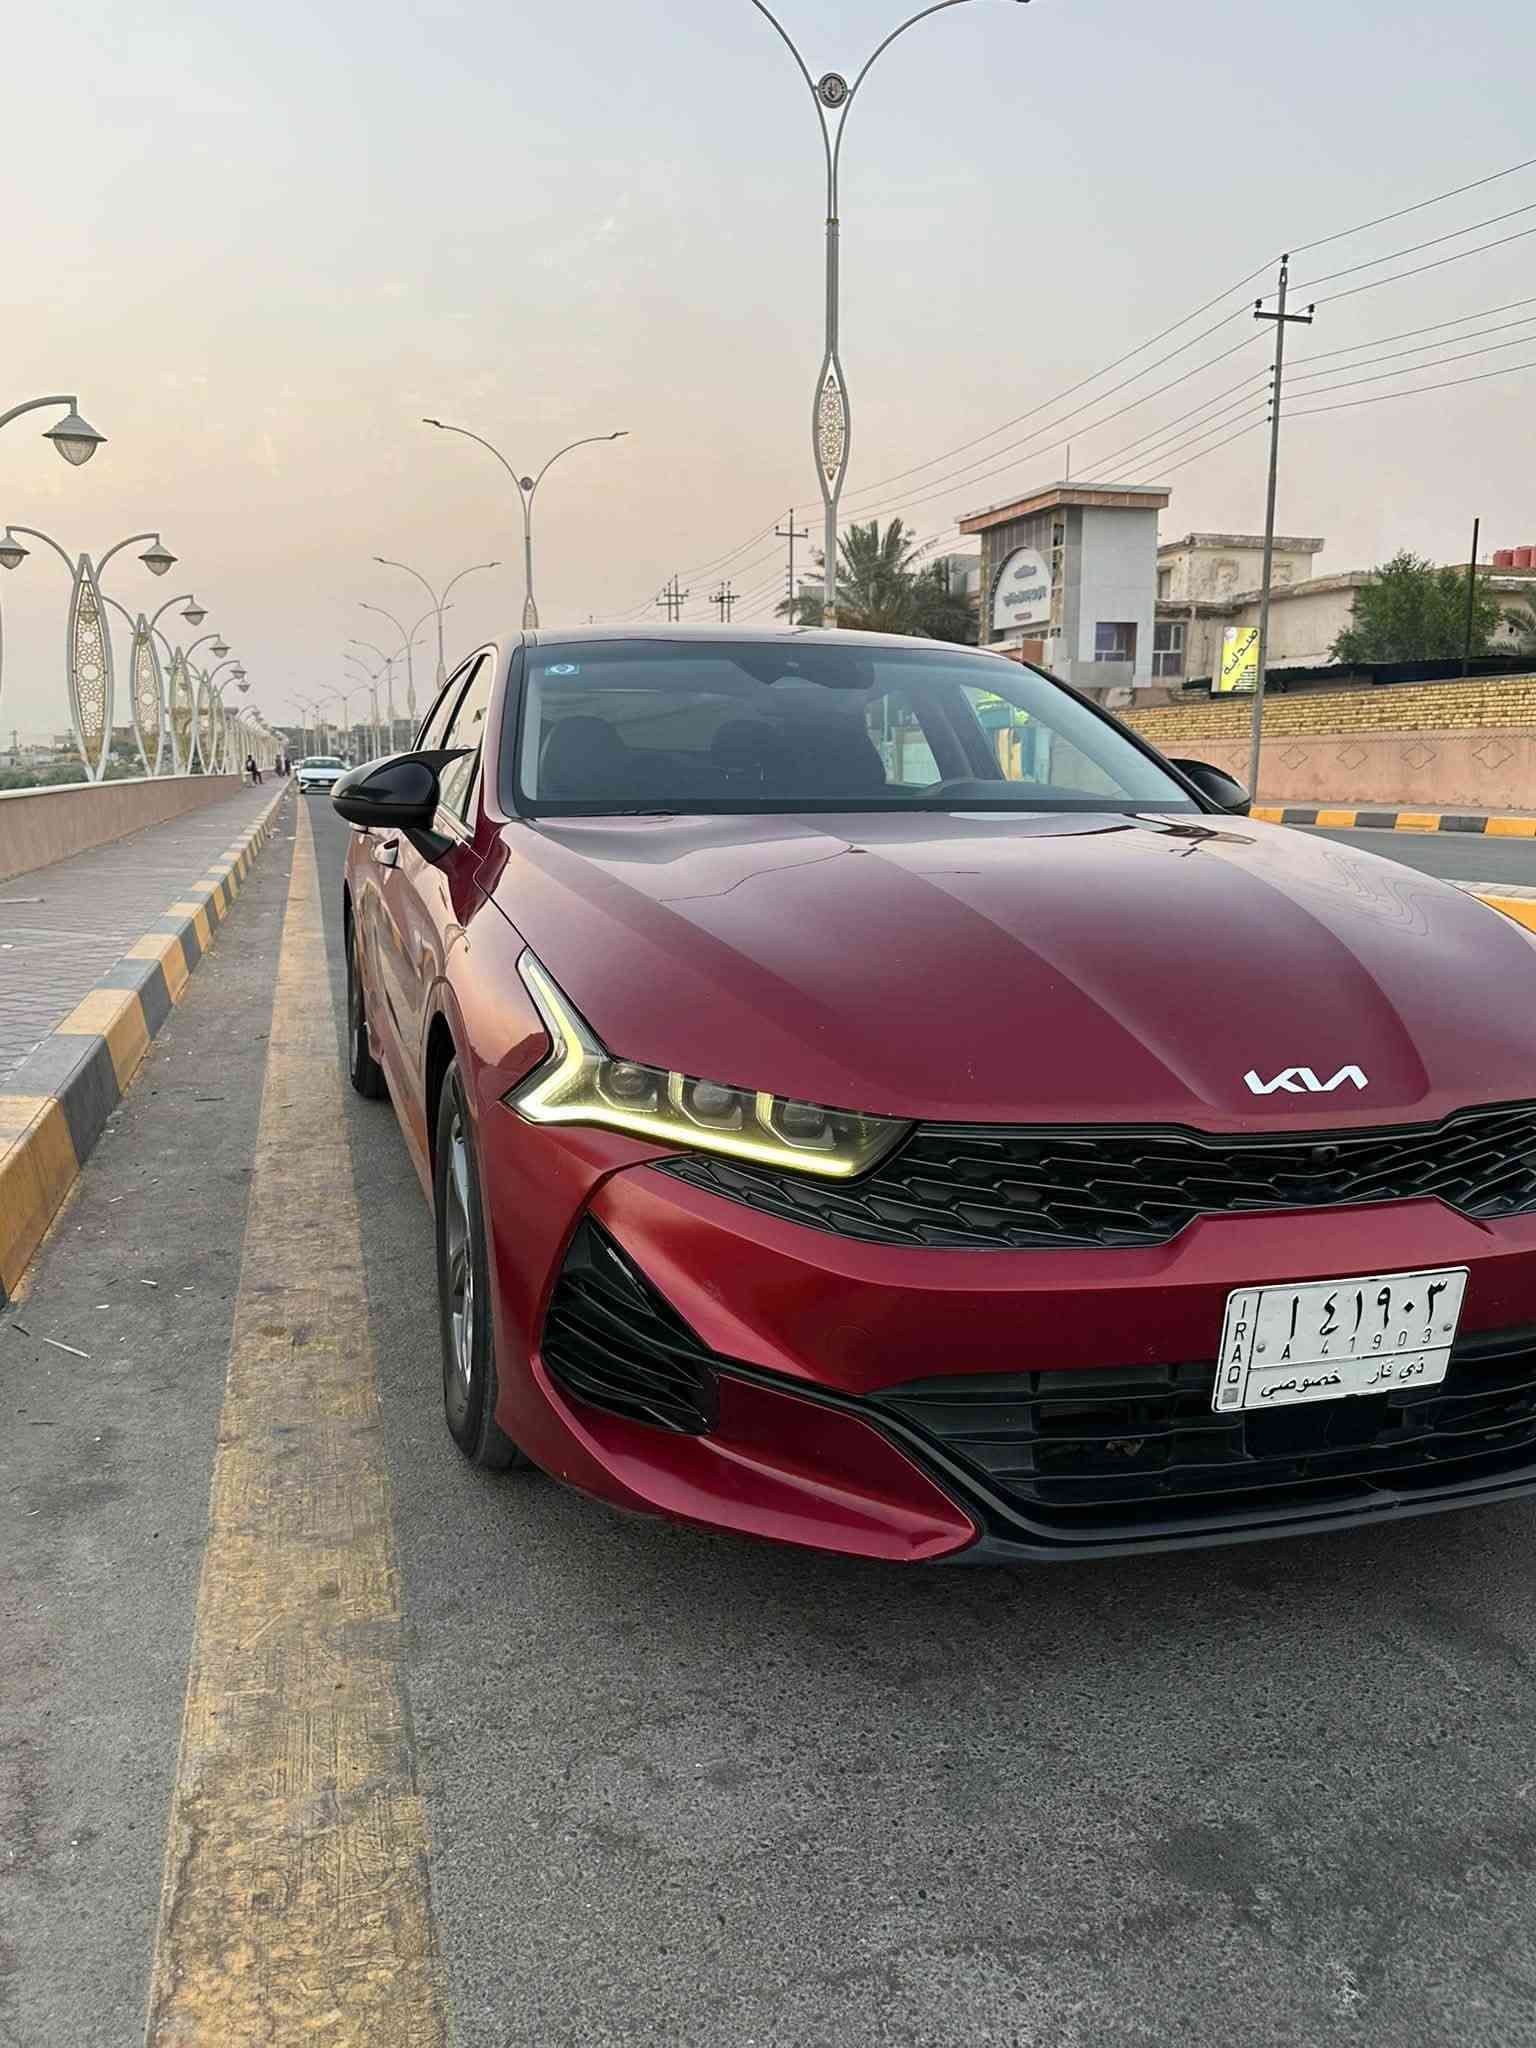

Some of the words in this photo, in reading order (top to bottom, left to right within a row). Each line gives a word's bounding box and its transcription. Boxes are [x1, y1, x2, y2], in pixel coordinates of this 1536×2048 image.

[1227, 1300, 1247, 1384] IRAQ
[1260, 1368, 1342, 1400] خصوصي
[1367, 1359, 1393, 1385] قار
[1399, 1355, 1425, 1385] ذي
